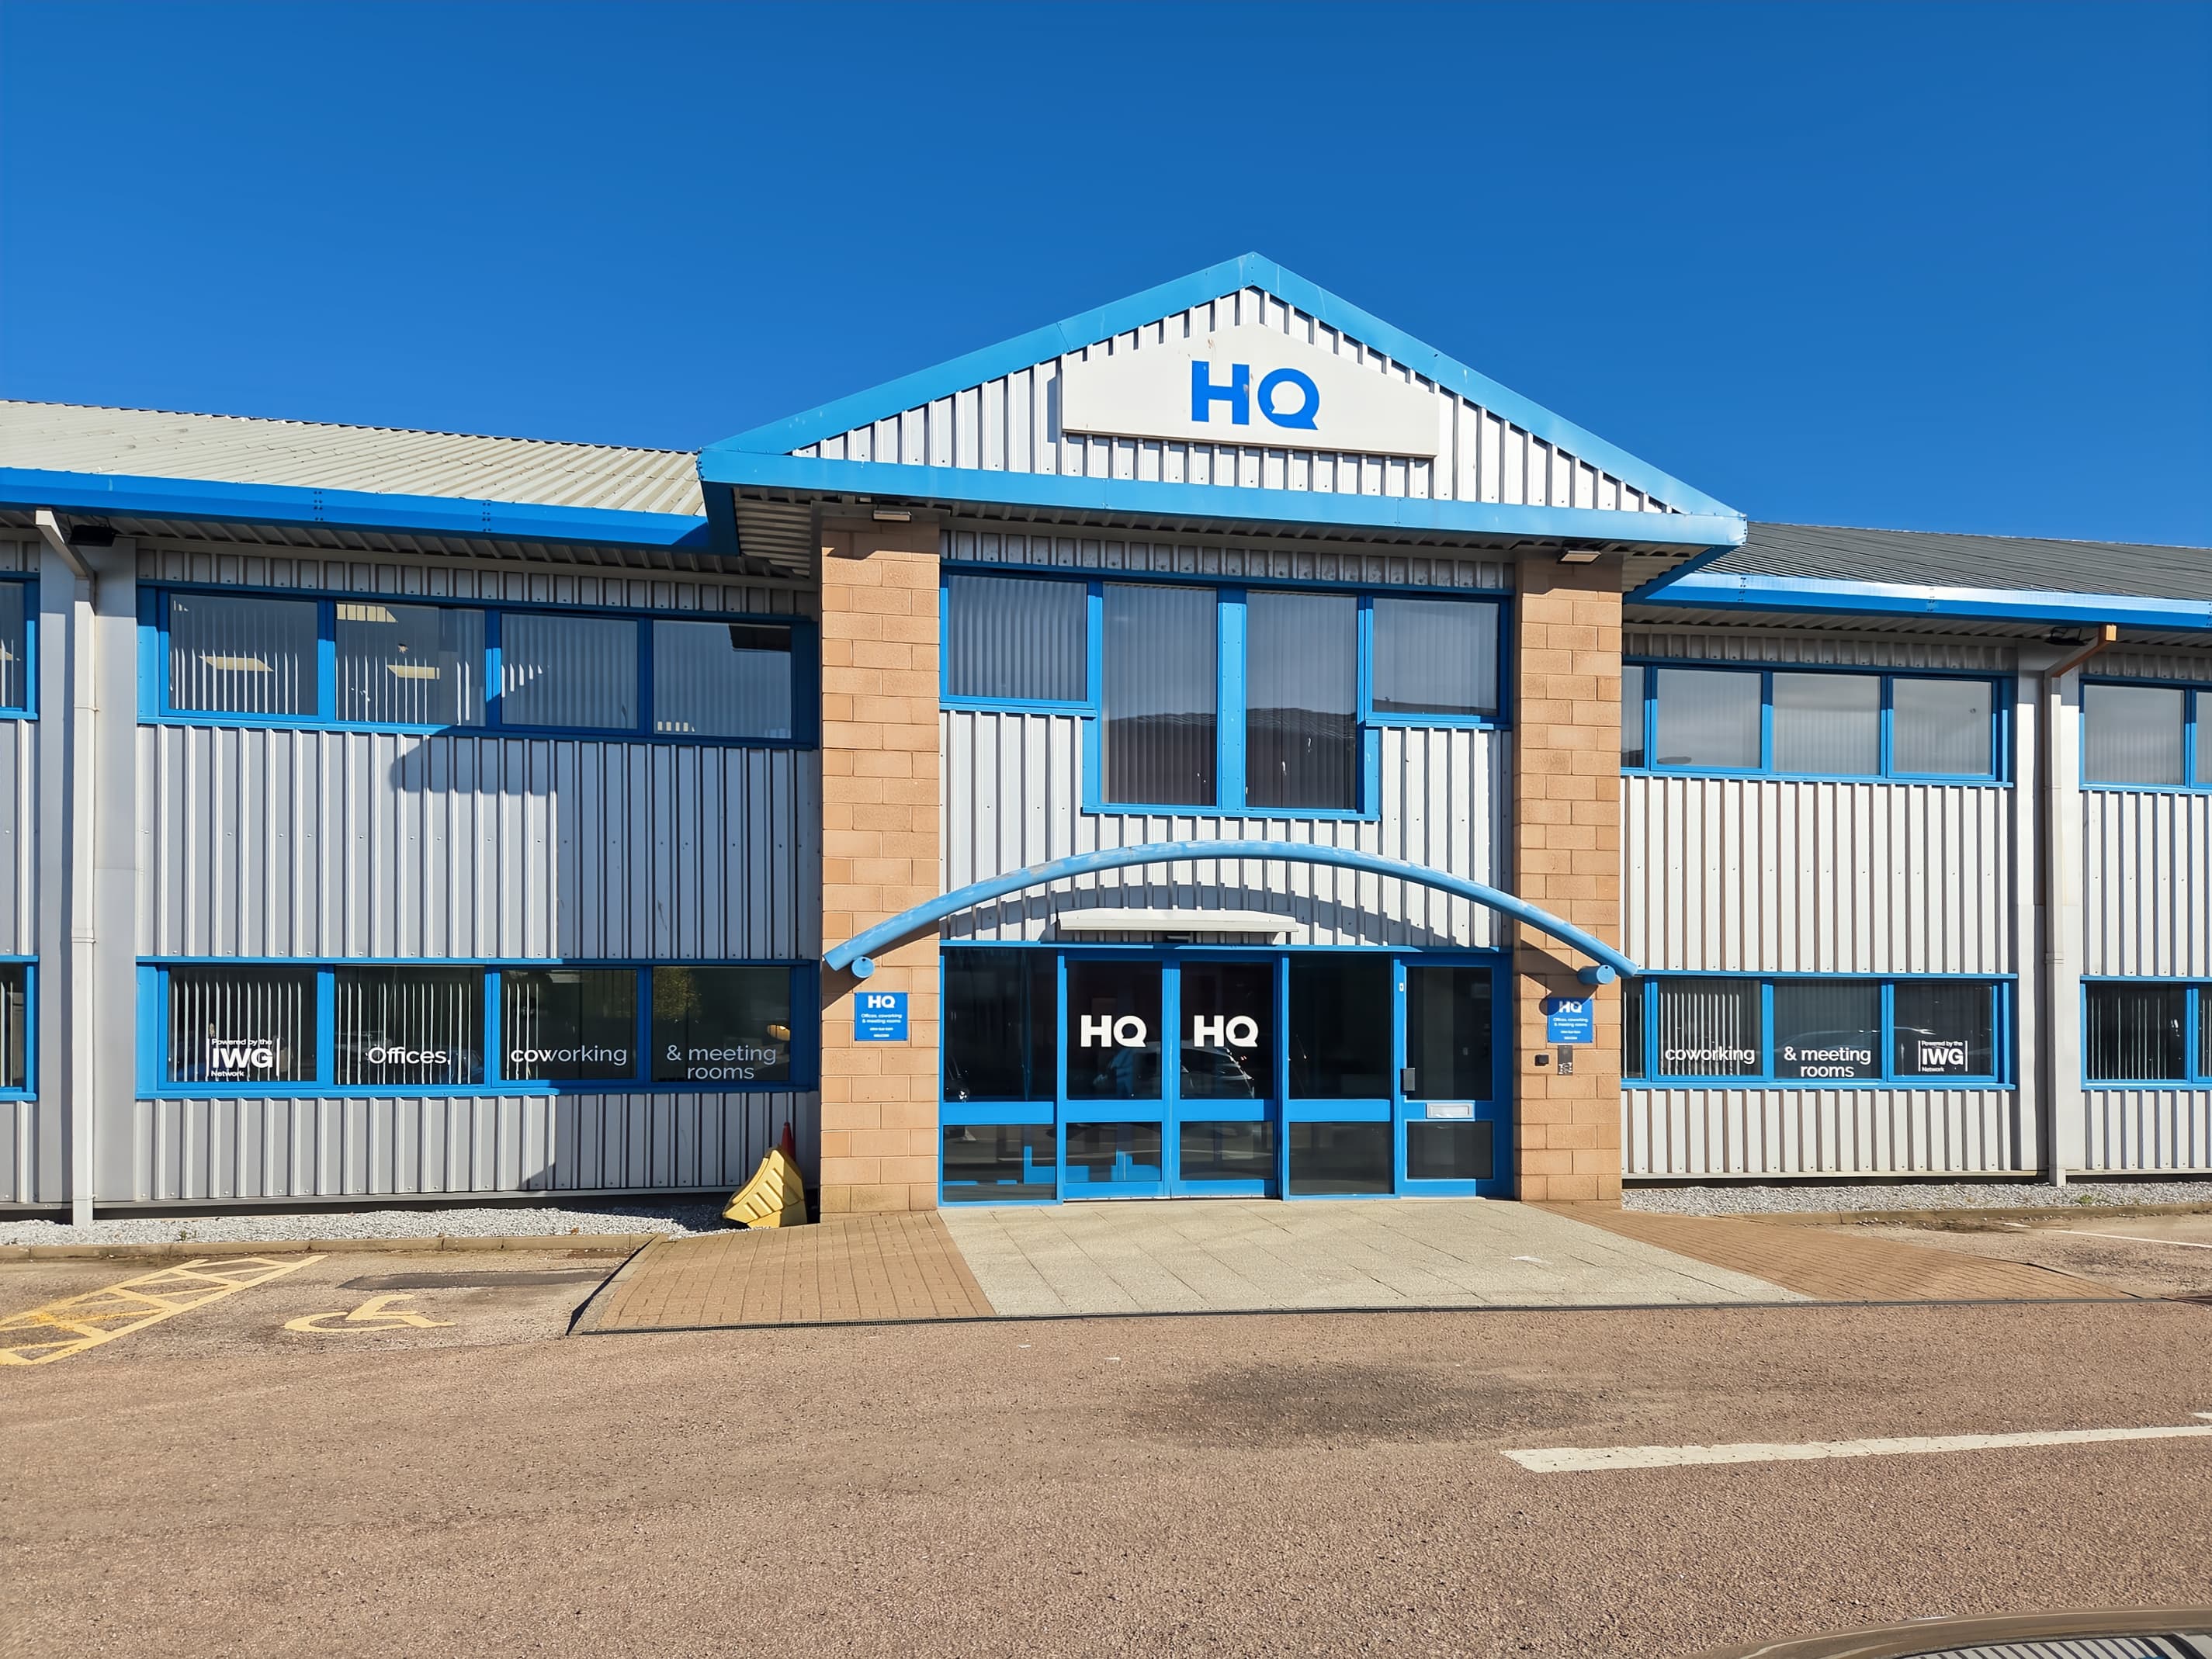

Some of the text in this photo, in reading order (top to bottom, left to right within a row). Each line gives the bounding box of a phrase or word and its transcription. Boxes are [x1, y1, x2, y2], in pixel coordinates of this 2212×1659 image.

[1191, 360, 1319, 430] HQ
[868, 995, 895, 1008] HQ
[1559, 1001, 1583, 1013] HQ
[1080, 1015, 1146, 1048] HQ
[1194, 1014, 1259, 1048] HQ
[213, 1048, 273, 1068] IWG
[511, 1045, 627, 1066] coworking
[667, 1044, 776, 1065] & meeting
[1665, 1045, 1755, 1064] coworking
[1784, 1046, 1871, 1065] & meeting
[1922, 1048, 1964, 1065] IWG
[688, 1067, 754, 1080] rooms
[1801, 1066, 1854, 1078] rooms
